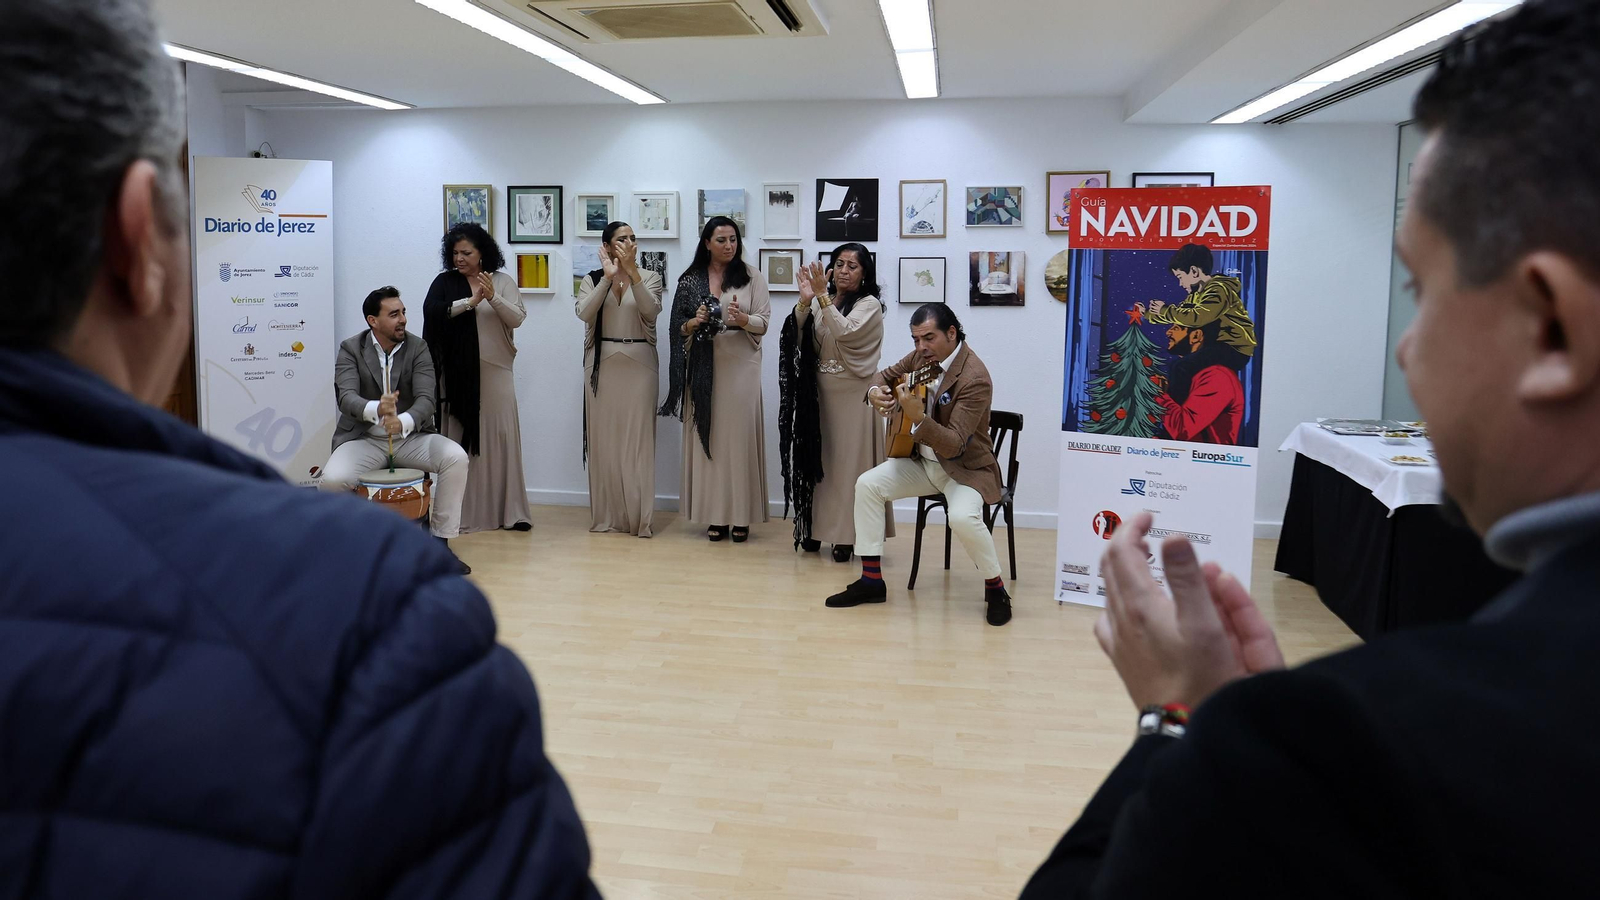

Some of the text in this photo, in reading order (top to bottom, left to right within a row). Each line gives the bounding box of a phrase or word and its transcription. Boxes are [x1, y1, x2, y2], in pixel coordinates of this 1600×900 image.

[261, 189, 277, 200] 40
[1080, 197, 1106, 206] Guía
[1080, 205, 1258, 237] NAVIDAD
[205, 217, 315, 237] Diario de Jerez
[231, 295, 266, 304] Verinsur
[235, 407, 303, 461] 40
[1068, 441, 1091, 449] DIARIO
[1091, 443, 1101, 451] DE
[1127, 446, 1180, 459] Diario de Jerez
[1192, 450, 1244, 463] EuropaSur
[1148, 480, 1188, 491] Diputación
[1148, 490, 1180, 500] de Cádiz
